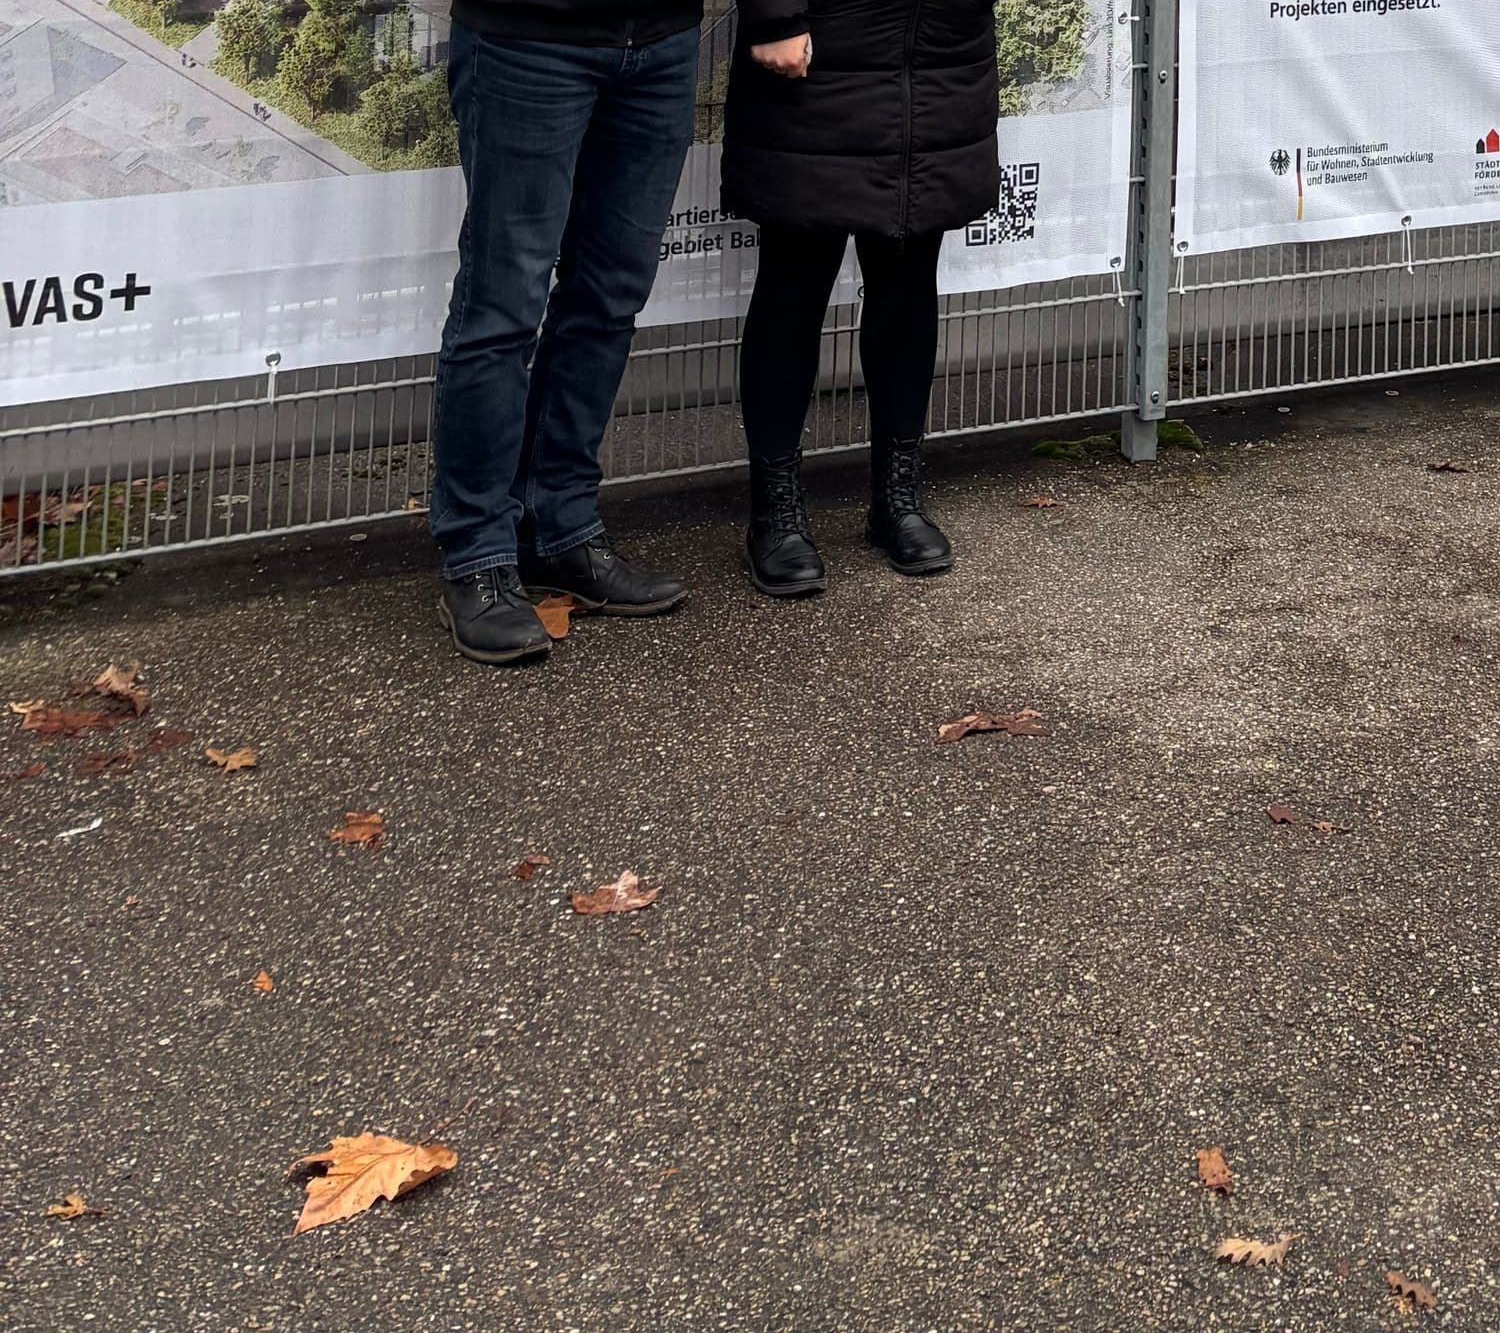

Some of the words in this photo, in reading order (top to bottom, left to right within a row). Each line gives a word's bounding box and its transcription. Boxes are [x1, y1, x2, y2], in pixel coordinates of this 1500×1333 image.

[1271, 0, 1346, 20] Projekten
[1306, 141, 1389, 158] Bundesministerium
[1306, 160, 1319, 172] für
[1321, 158, 1360, 170] Wohnen,
[1361, 150, 1434, 167] Stadtentwicklung
[1306, 175, 1322, 186] und
[1325, 171, 1368, 184] Bauwesen
